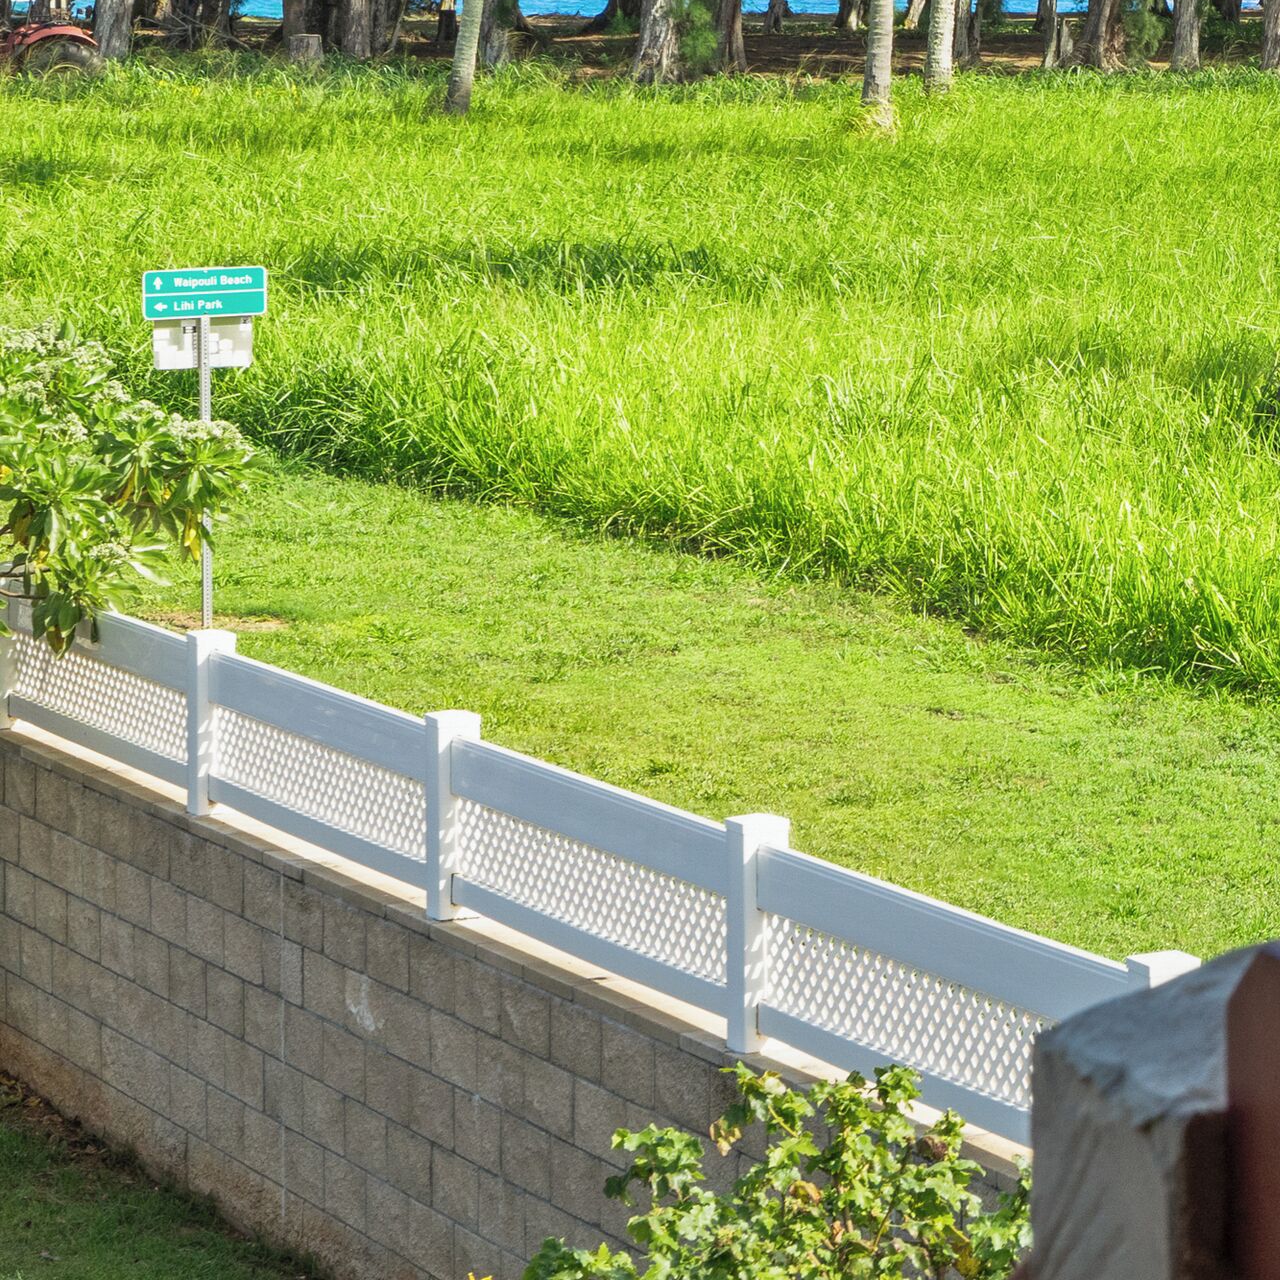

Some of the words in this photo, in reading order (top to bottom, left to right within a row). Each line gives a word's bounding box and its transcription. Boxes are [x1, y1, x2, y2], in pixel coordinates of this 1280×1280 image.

[174, 276, 217, 288] Waipouli
[220, 275, 252, 285] Beach
[174, 300, 194, 311] Lihi
[198, 300, 222, 310] Park
